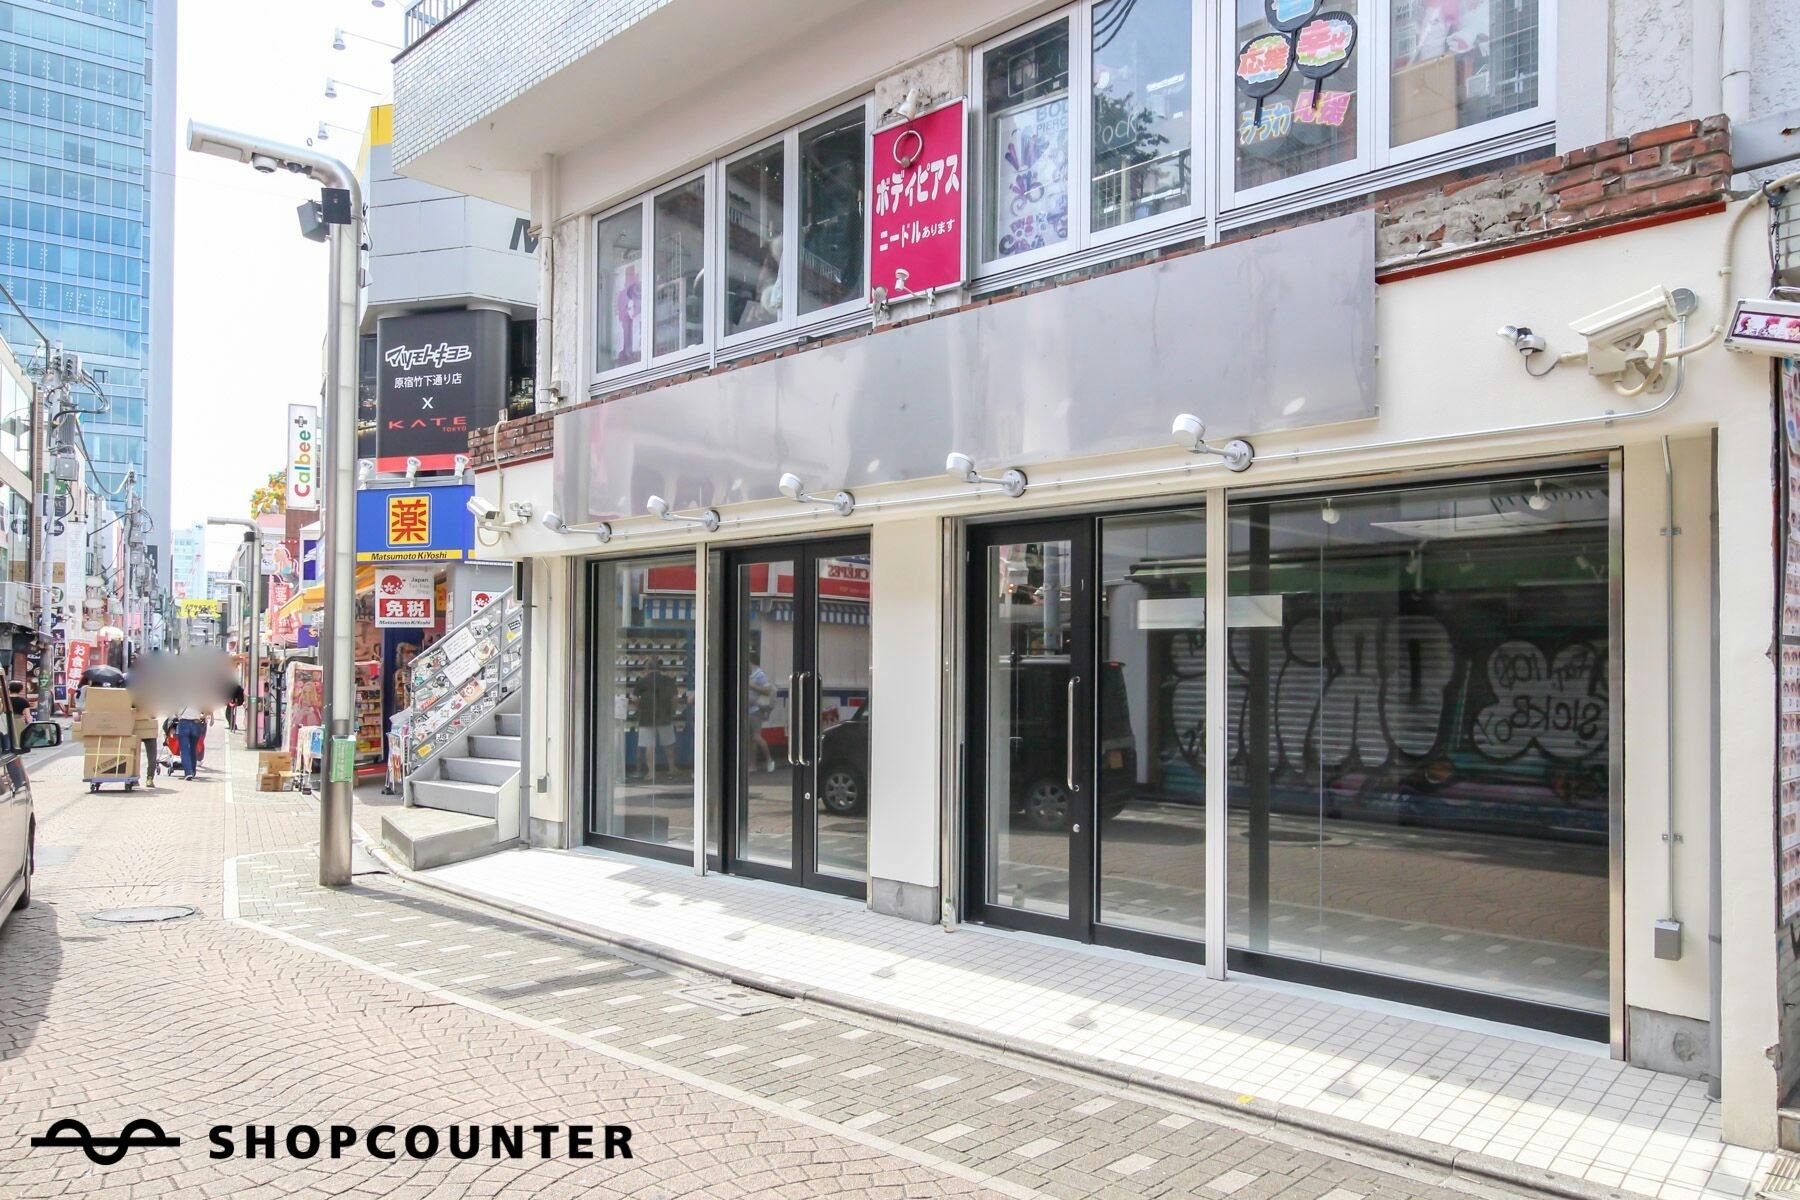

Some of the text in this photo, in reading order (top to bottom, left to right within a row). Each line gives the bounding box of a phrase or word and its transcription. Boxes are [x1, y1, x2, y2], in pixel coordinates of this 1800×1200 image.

[875, 154, 960, 217] ボディピアス
[385, 342, 472, 370] マツモトキヨシ
[394, 372, 463, 389] 原宿竹下通り店
[388, 416, 467, 430] KATE
[392, 499, 427, 542] 薬
[371, 551, 447, 561] Matsumoto KiYoshi
[385, 600, 425, 617] 免税
